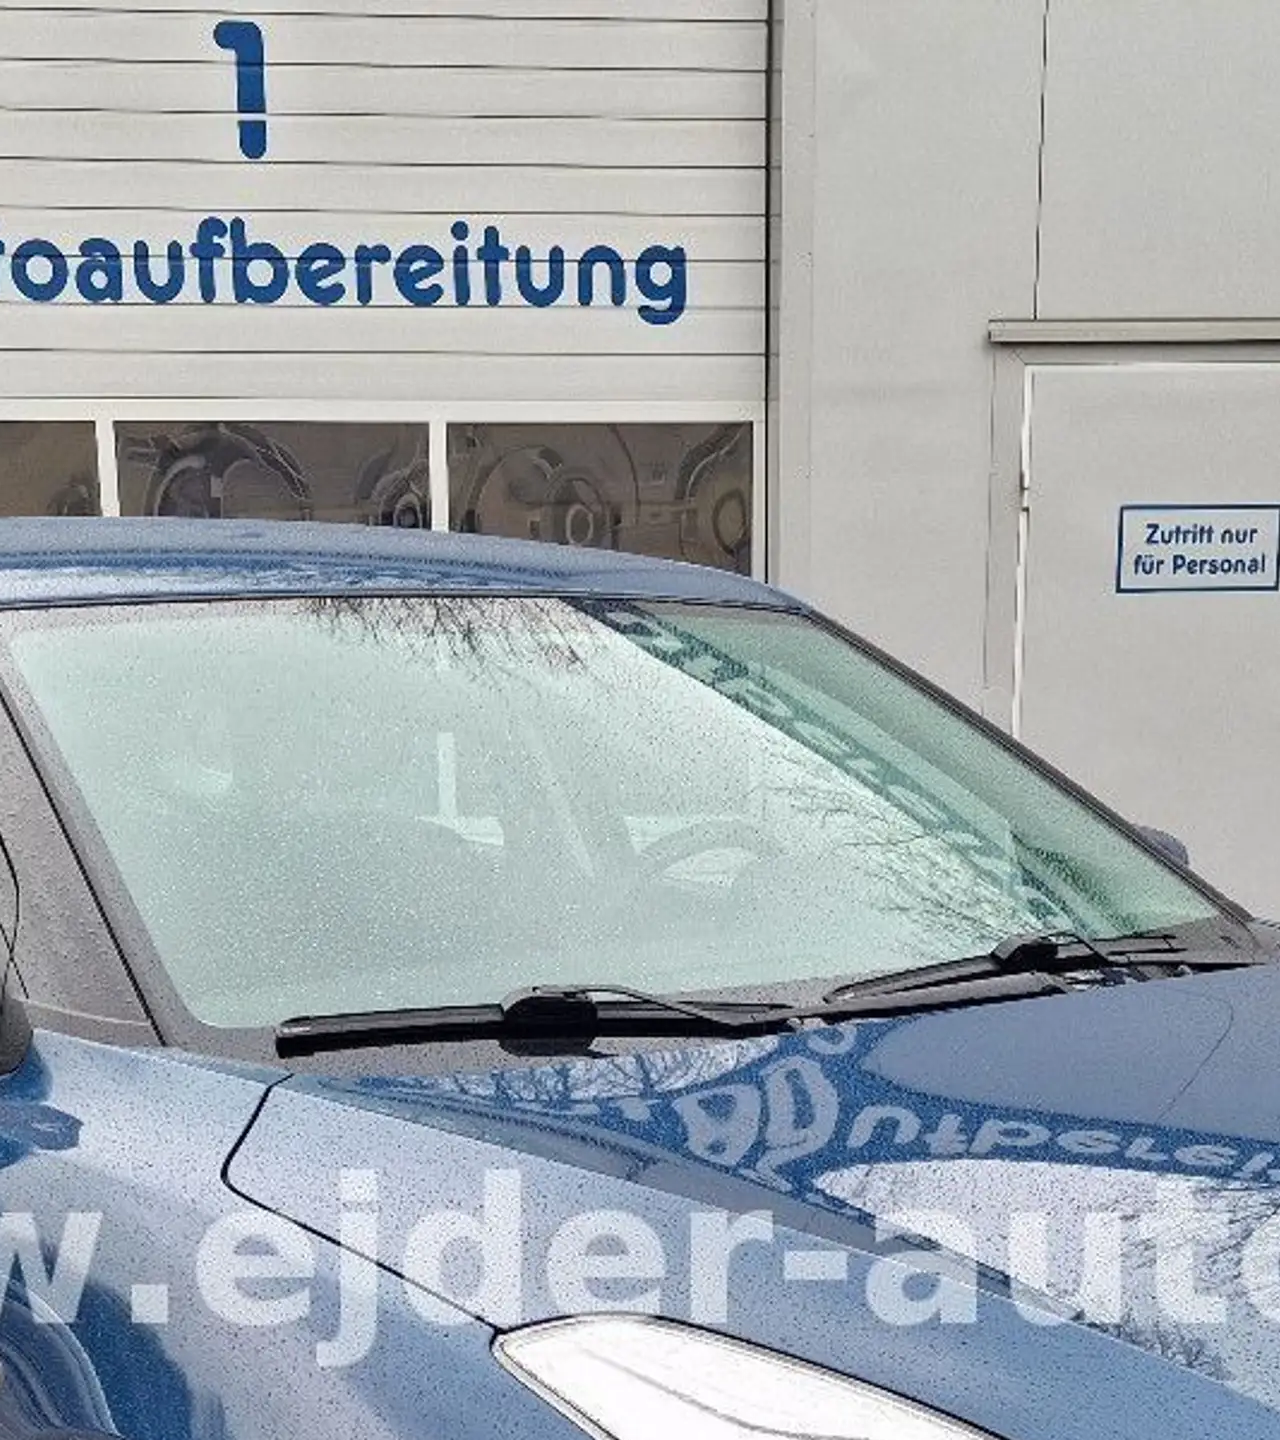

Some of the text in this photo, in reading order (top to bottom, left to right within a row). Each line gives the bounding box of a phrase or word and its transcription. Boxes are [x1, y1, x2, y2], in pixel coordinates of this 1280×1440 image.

[214, 20, 268, 159] 1
[1145, 523, 1259, 545] Zutritt nur
[1133, 552, 1266, 575] für Personal
